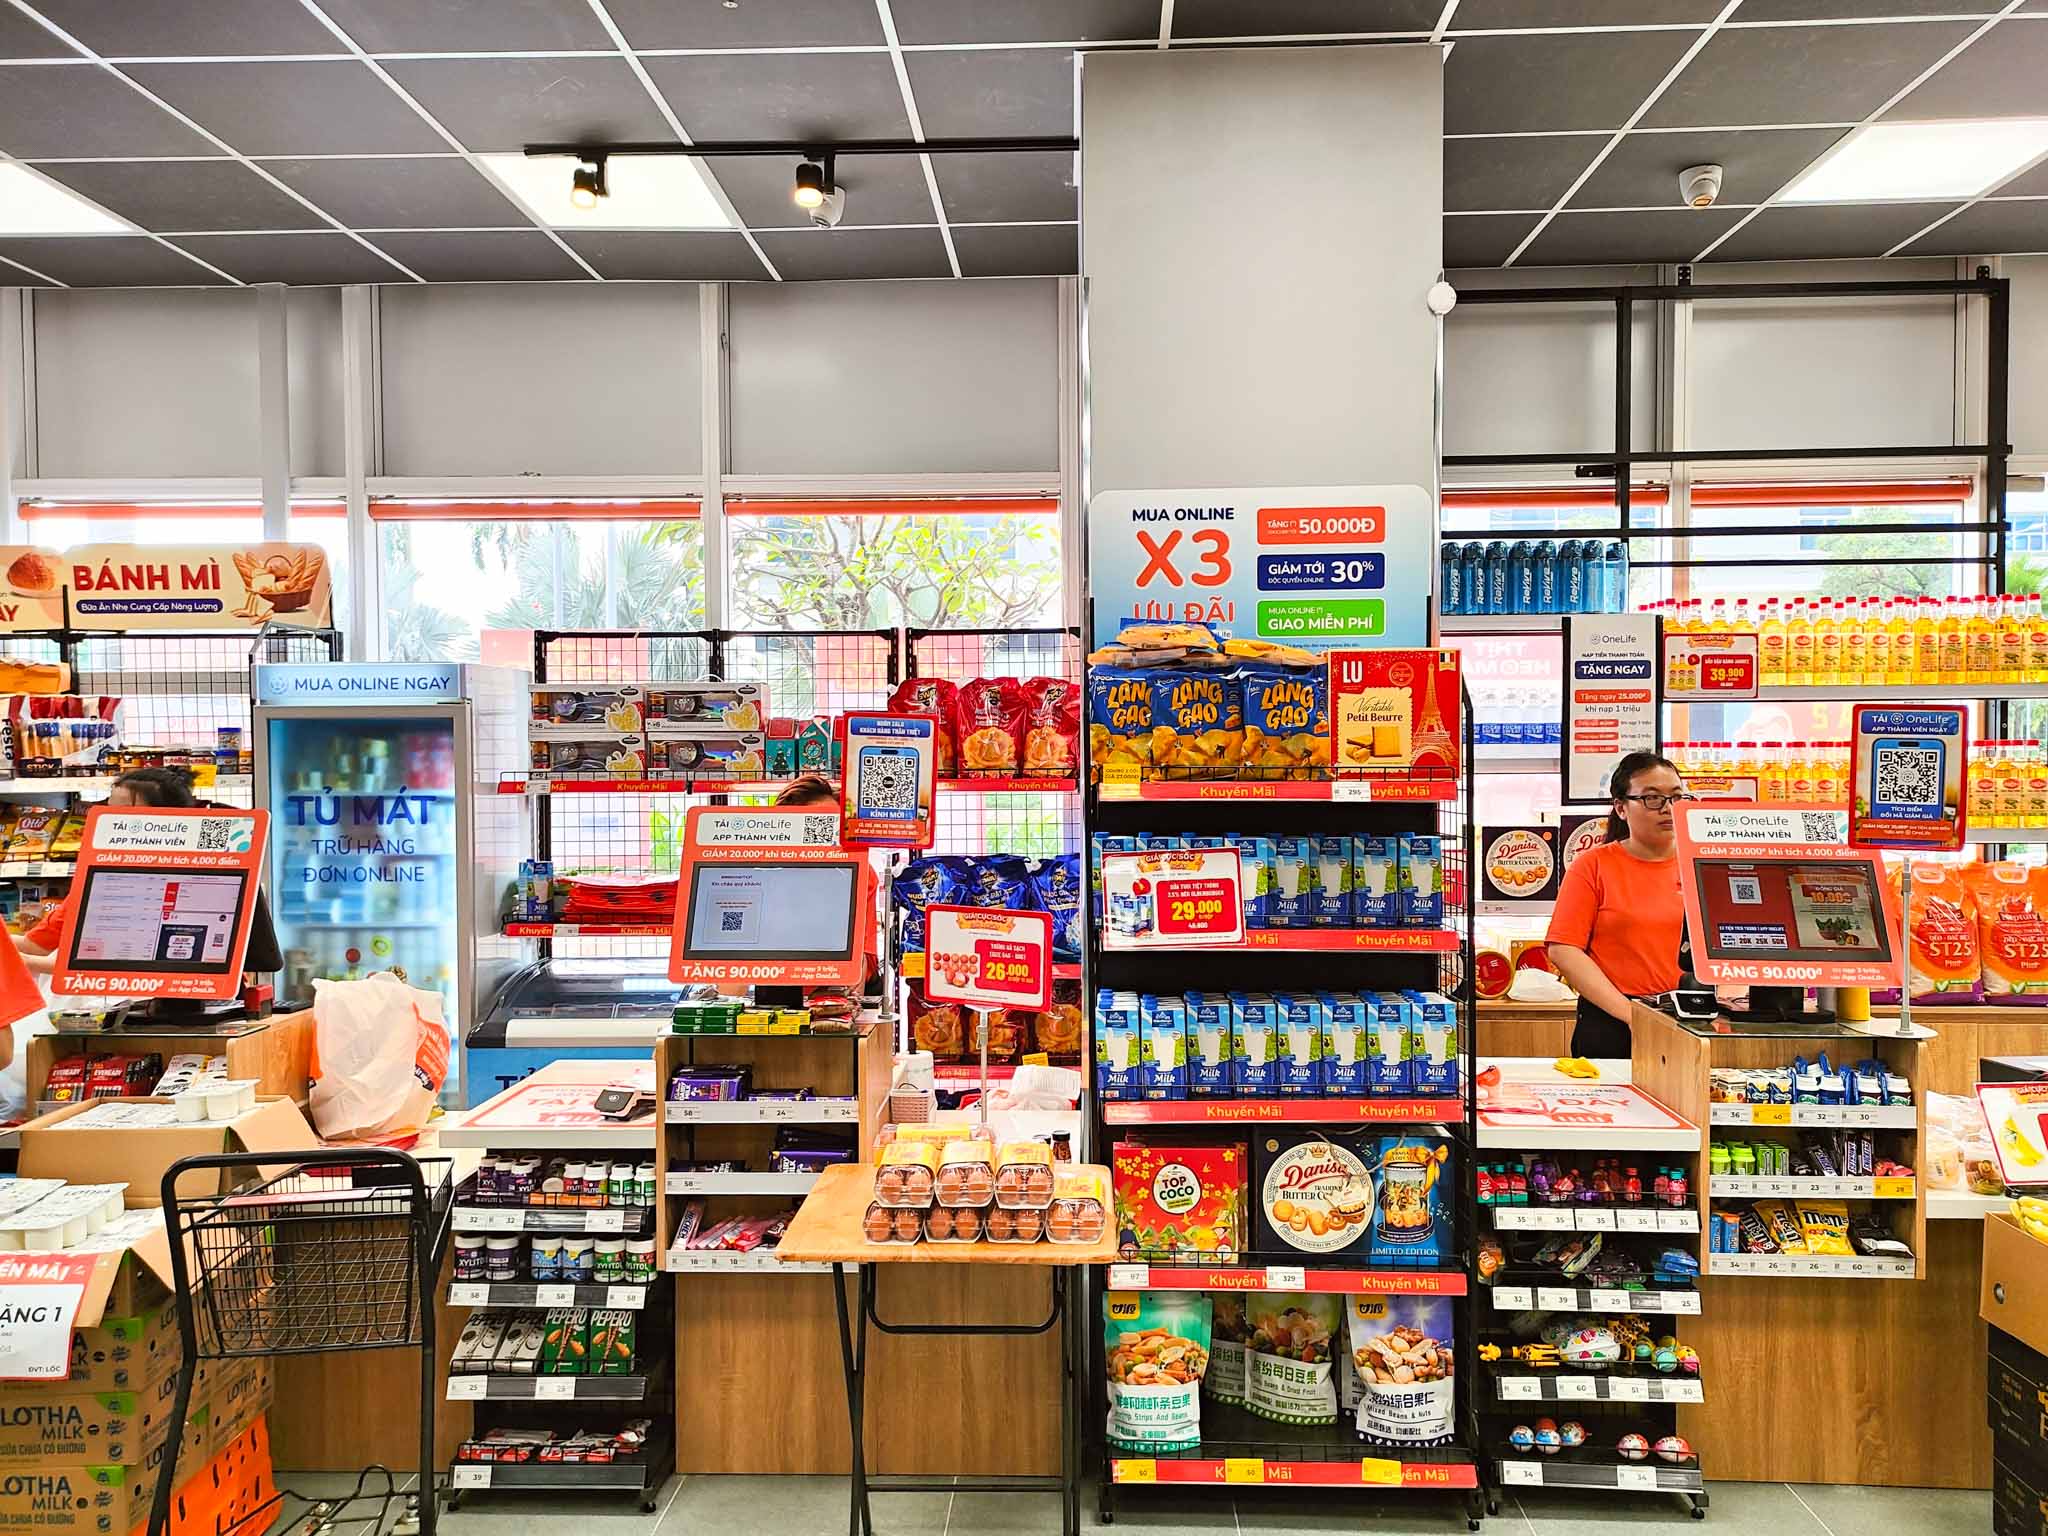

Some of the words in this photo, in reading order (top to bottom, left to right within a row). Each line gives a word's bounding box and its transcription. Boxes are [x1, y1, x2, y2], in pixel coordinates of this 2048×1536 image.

[1132, 508, 1170, 521] MUA
[1174, 507, 1235, 520] ONLINE
[1299, 518, 1376, 534] 50.000Đ
[1135, 528, 1233, 588] X3
[72, 558, 170, 591] BÁNH
[180, 556, 222, 590] MÌ
[1268, 561, 1301, 575] GIẢM
[1303, 560, 1325, 574] TỚI
[1330, 560, 1375, 583] 30%
[111, 602, 129, 613] Nhẹ
[129, 602, 152, 613] Cung
[152, 601, 170, 613] Cấp
[171, 601, 193, 612] Năng
[1133, 599, 1174, 622] ƯU
[1184, 595, 1235, 623] ĐÃI
[1268, 607, 1287, 615] MUA
[1268, 617, 1305, 630] GIAO
[1308, 612, 1345, 630] MIỄN
[1348, 613, 1374, 629] PHÍ
[1602, 634, 1637, 644] OneLife
[1343, 660, 1363, 684] LU
[1581, 663, 1612, 677] TẶNG
[1614, 665, 1646, 675] NGAY
[294, 677, 333, 691] MUA
[338, 677, 400, 690] ONLINE
[404, 676, 450, 690] NGAY
[1585, 704, 1597, 713] khi
[1346, 713, 1370, 722] Petit
[1370, 713, 1404, 722] Beurre
[1872, 715, 1888, 723] TẢI
[1906, 714, 1948, 724] OneLife
[1200, 784, 1249, 799] Khuyến
[1253, 785, 1276, 796] Mãi
[1407, 784, 1430, 796] Mãi
[288, 786, 340, 826] TỦ
[353, 786, 438, 825] MÁT
[113, 819, 128, 832] TẢI
[144, 821, 189, 833] OneLife
[714, 818, 730, 828] TẢI
[746, 819, 792, 830] OneLife
[1704, 814, 1722, 825] TẢI
[1740, 815, 1789, 826] OneLife
[712, 834, 732, 842] APP
[734, 832, 767, 842] THÀNH
[769, 833, 791, 842] VIÊN
[1707, 830, 1727, 838] APP
[1729, 829, 1766, 839] THÀNH
[1768, 830, 1792, 839] VIÊN
[109, 837, 128, 845] APP
[130, 836, 162, 846] THÀNH
[163, 836, 186, 847] VIÊN
[311, 834, 351, 854] TRỮ
[357, 835, 415, 855] HÀNG
[702, 849, 728, 858] GIẢM
[765, 850, 779, 859] khi
[781, 850, 798, 859] tích
[799, 851, 825, 859] 4.000
[826, 850, 849, 859] điểm
[1494, 841, 1538, 859] Danisa
[1700, 846, 1728, 856] GIẢM
[1768, 847, 1783, 857] khi
[1785, 847, 1804, 857] tích
[1805, 848, 1833, 857] 4.000
[96, 853, 122, 864] GIẢM
[159, 855, 171, 865] khi
[173, 855, 190, 866] tích
[191, 857, 217, 865] 4.000
[303, 865, 350, 882] ĐƠN
[353, 866, 425, 882] ONLINE
[1171, 899, 1223, 921] 29.000
[1277, 900, 1299, 911] Milk
[1320, 899, 1342, 910] Milk
[1365, 899, 1386, 910] Milk
[1412, 899, 1434, 909] Milk
[1255, 933, 1279, 945] Mãi
[1356, 932, 1405, 947] Khuyến
[1409, 933, 1433, 946] Mãi
[682, 962, 726, 982] TẶNG
[986, 961, 1029, 981] 26.000
[1709, 963, 1758, 981] TẶNG
[63, 973, 106, 993] TẶNG
[1108, 1074, 1129, 1084] Milk
[1154, 1074, 1176, 1083] Milk
[1200, 1068, 1221, 1078] Milk
[1207, 1104, 1255, 1118] Khuyến
[1259, 1105, 1283, 1117] Mãi
[1359, 1103, 1409, 1119] Khuyến
[1413, 1104, 1436, 1116] Mãi
[1161, 1176, 1187, 1190] TOP
[1159, 1185, 1195, 1200] COCO
[1282, 1190, 1315, 1201] BUTTER
[1517, 1215, 1527, 1223] 35
[1371, 1247, 1404, 1256] LIMITED
[1405, 1248, 1439, 1256] EDITION
[27, 1262, 71, 1281] MÃI
[1209, 1272, 1259, 1288] Khuyến
[1362, 1277, 1411, 1291] Khuyến
[1416, 1277, 1440, 1289] Mãi
[545, 1308, 588, 1326] PEPERO
[590, 1310, 633, 1327] PEPERO
[0, 1406, 84, 1427] LOTHA
[41, 1424, 84, 1441] MILK
[32, 1496, 73, 1511] MILK
